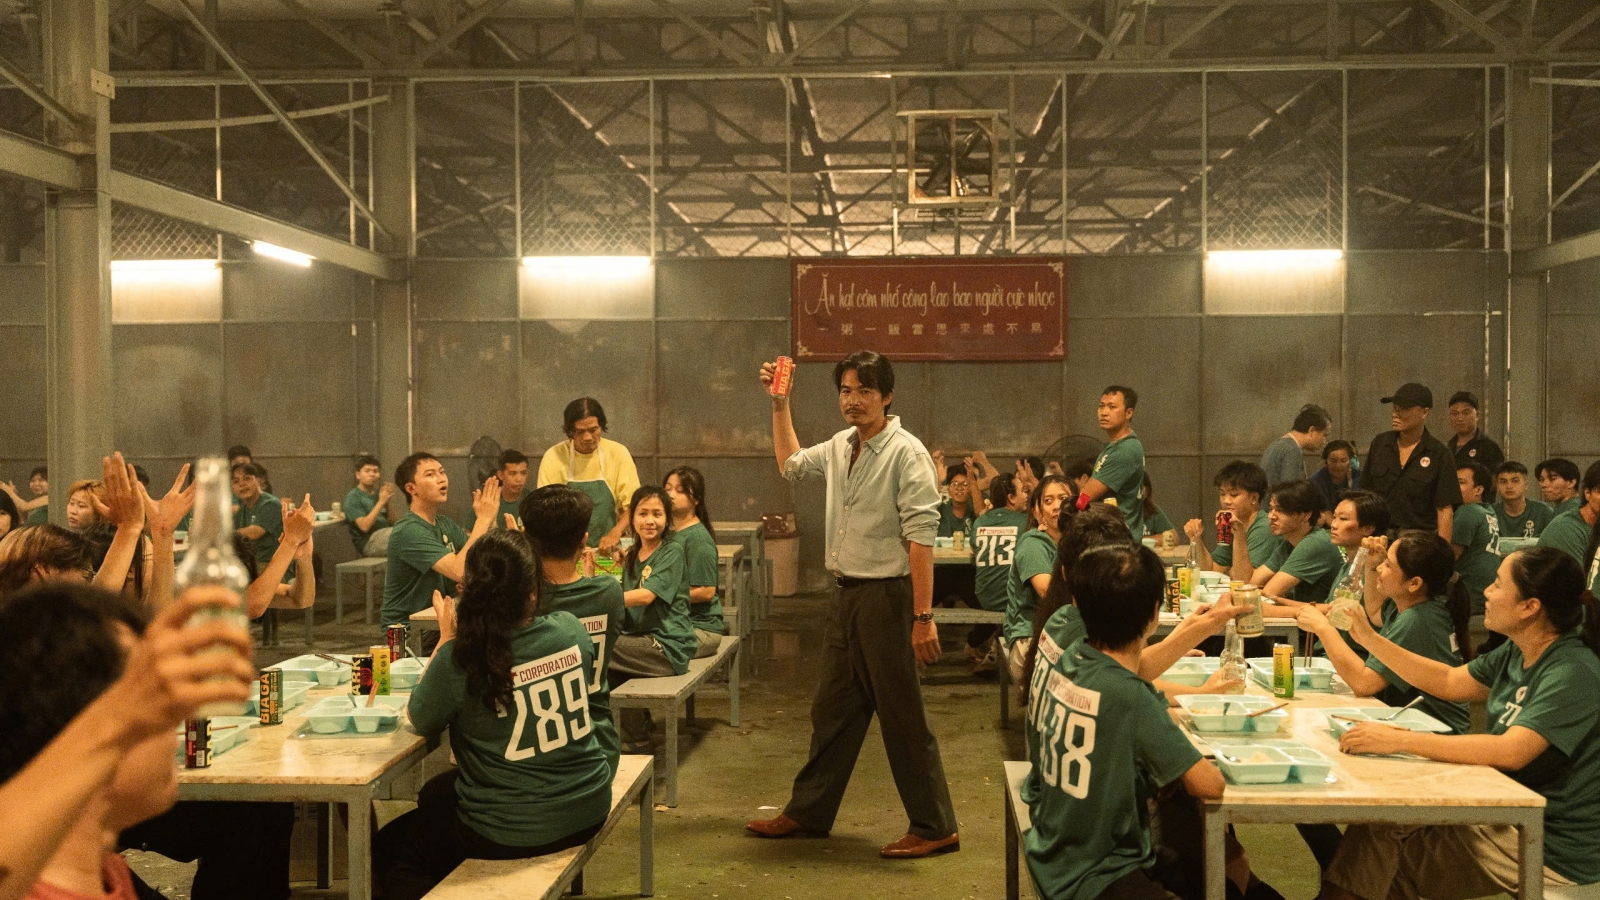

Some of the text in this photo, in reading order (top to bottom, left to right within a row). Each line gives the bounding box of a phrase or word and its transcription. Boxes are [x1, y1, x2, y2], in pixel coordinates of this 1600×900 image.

[804, 272, 835, 316] Ăn
[838, 282, 855, 311] hạt
[902, 288, 928, 317] công
[930, 281, 950, 307] lao
[952, 281, 973, 307] bao
[975, 283, 1004, 317] người
[1006, 287, 1026, 310] cực
[1027, 281, 1056, 310] nhọc
[975, 535, 1017, 567] 213
[519, 652, 578, 683] CORPORATION
[260, 673, 270, 724] BIAGA
[495, 667, 591, 762] 289
